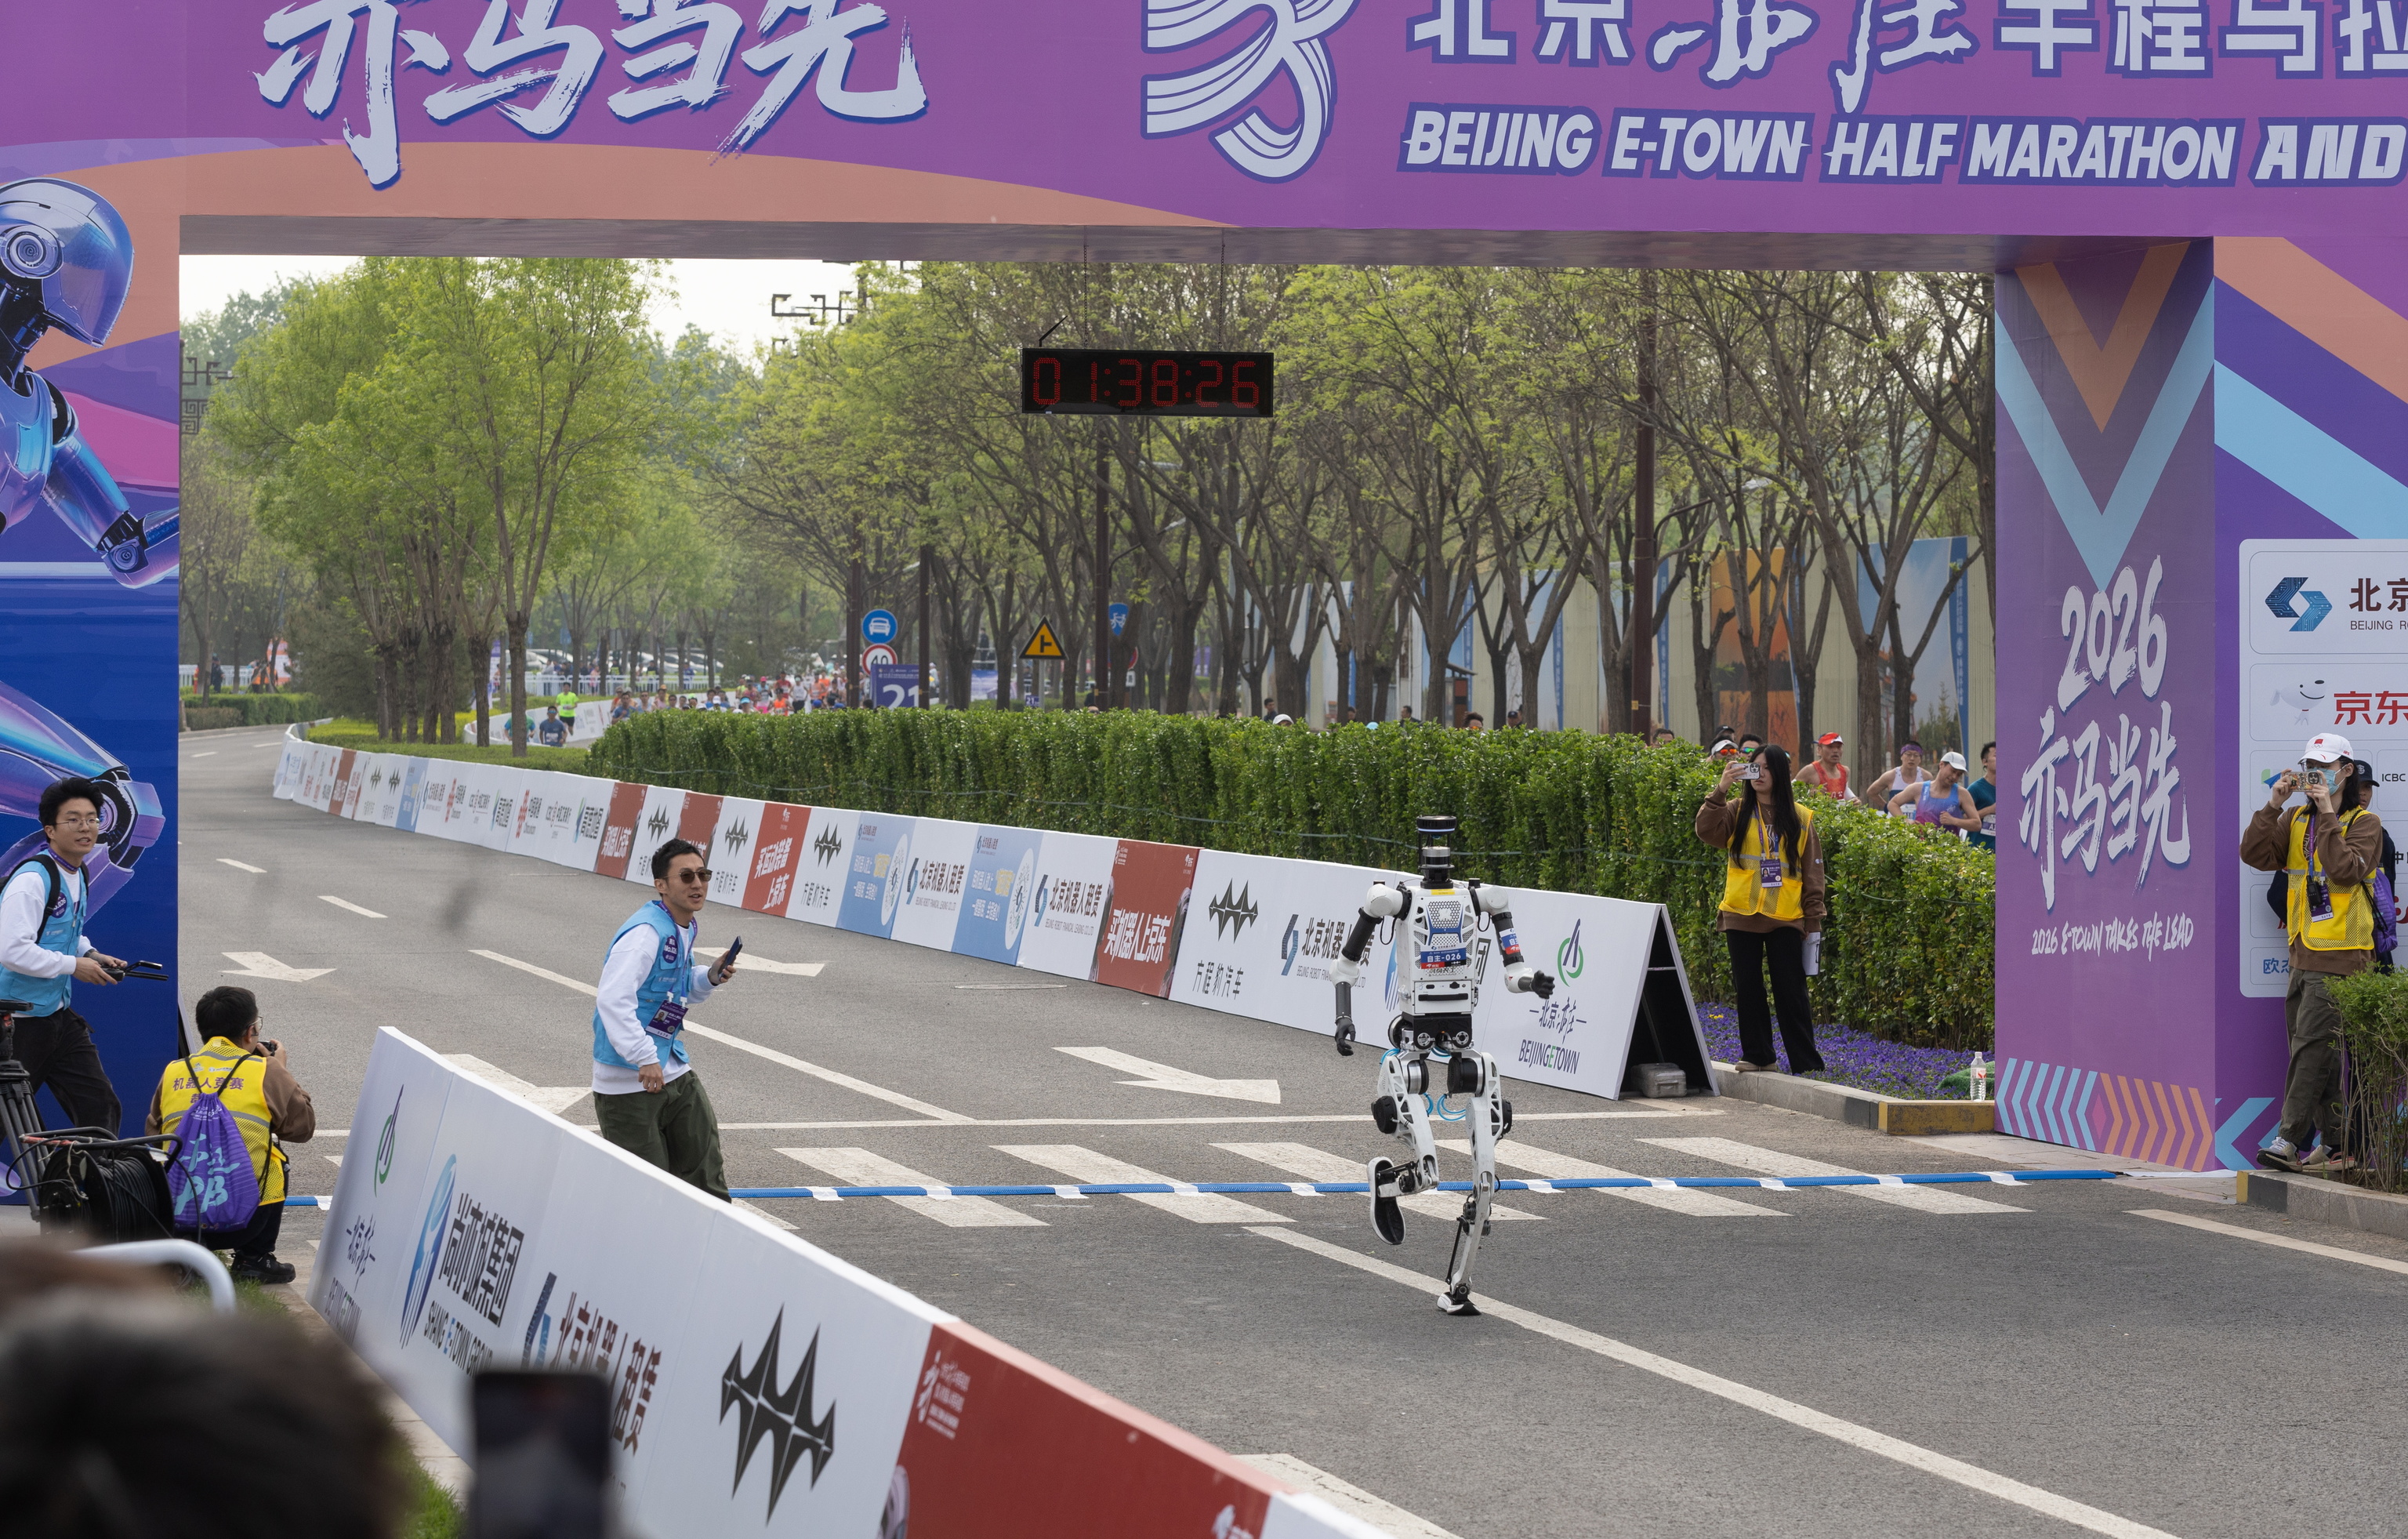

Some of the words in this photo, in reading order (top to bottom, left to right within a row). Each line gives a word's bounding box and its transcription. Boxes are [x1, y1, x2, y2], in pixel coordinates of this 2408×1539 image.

[251, 0, 928, 191] 亦马当先
[1404, 110, 1594, 169] BEIJING
[1610, 115, 1811, 176] E-TOWN
[1824, 121, 1959, 177] HALF
[1967, 123, 2236, 181] MARATHON
[2254, 124, 2408, 180] AND
[1033, 358, 1260, 408] 01:38:26
[2057, 554, 2167, 712] 2026
[2350, 620, 2393, 630] BEIJING
[2334, 691, 2408, 725] 京东
[2381, 773, 2406, 782] ICBC
[2019, 701, 2191, 910] 亦马当先
[919, 860, 965, 895] 北京机器人租赁
[2395, 851, 2408, 865] 中
[1050, 877, 1103, 918] 北京机器人租赁
[1104, 907, 1172, 964] 买机器人上京东
[2031, 926, 2058, 955] 2026
[2061, 920, 2104, 957] E-TOWN
[2105, 916, 2139, 954] TAKES
[2141, 911, 2163, 962] THE
[2163, 912, 2194, 951] LEAD
[1427, 953, 1461, 963] 自主-026
[1192, 960, 1244, 1000] 方程豹汽车
[1518, 1039, 1580, 1075] BEIJINGETOWN
[173, 1076, 245, 1091] 机器人竞赛
[174, 1175, 228, 1215] PB
[438, 1192, 525, 1328] 尚亦城集团
[424, 1300, 449, 1349] SHANG
